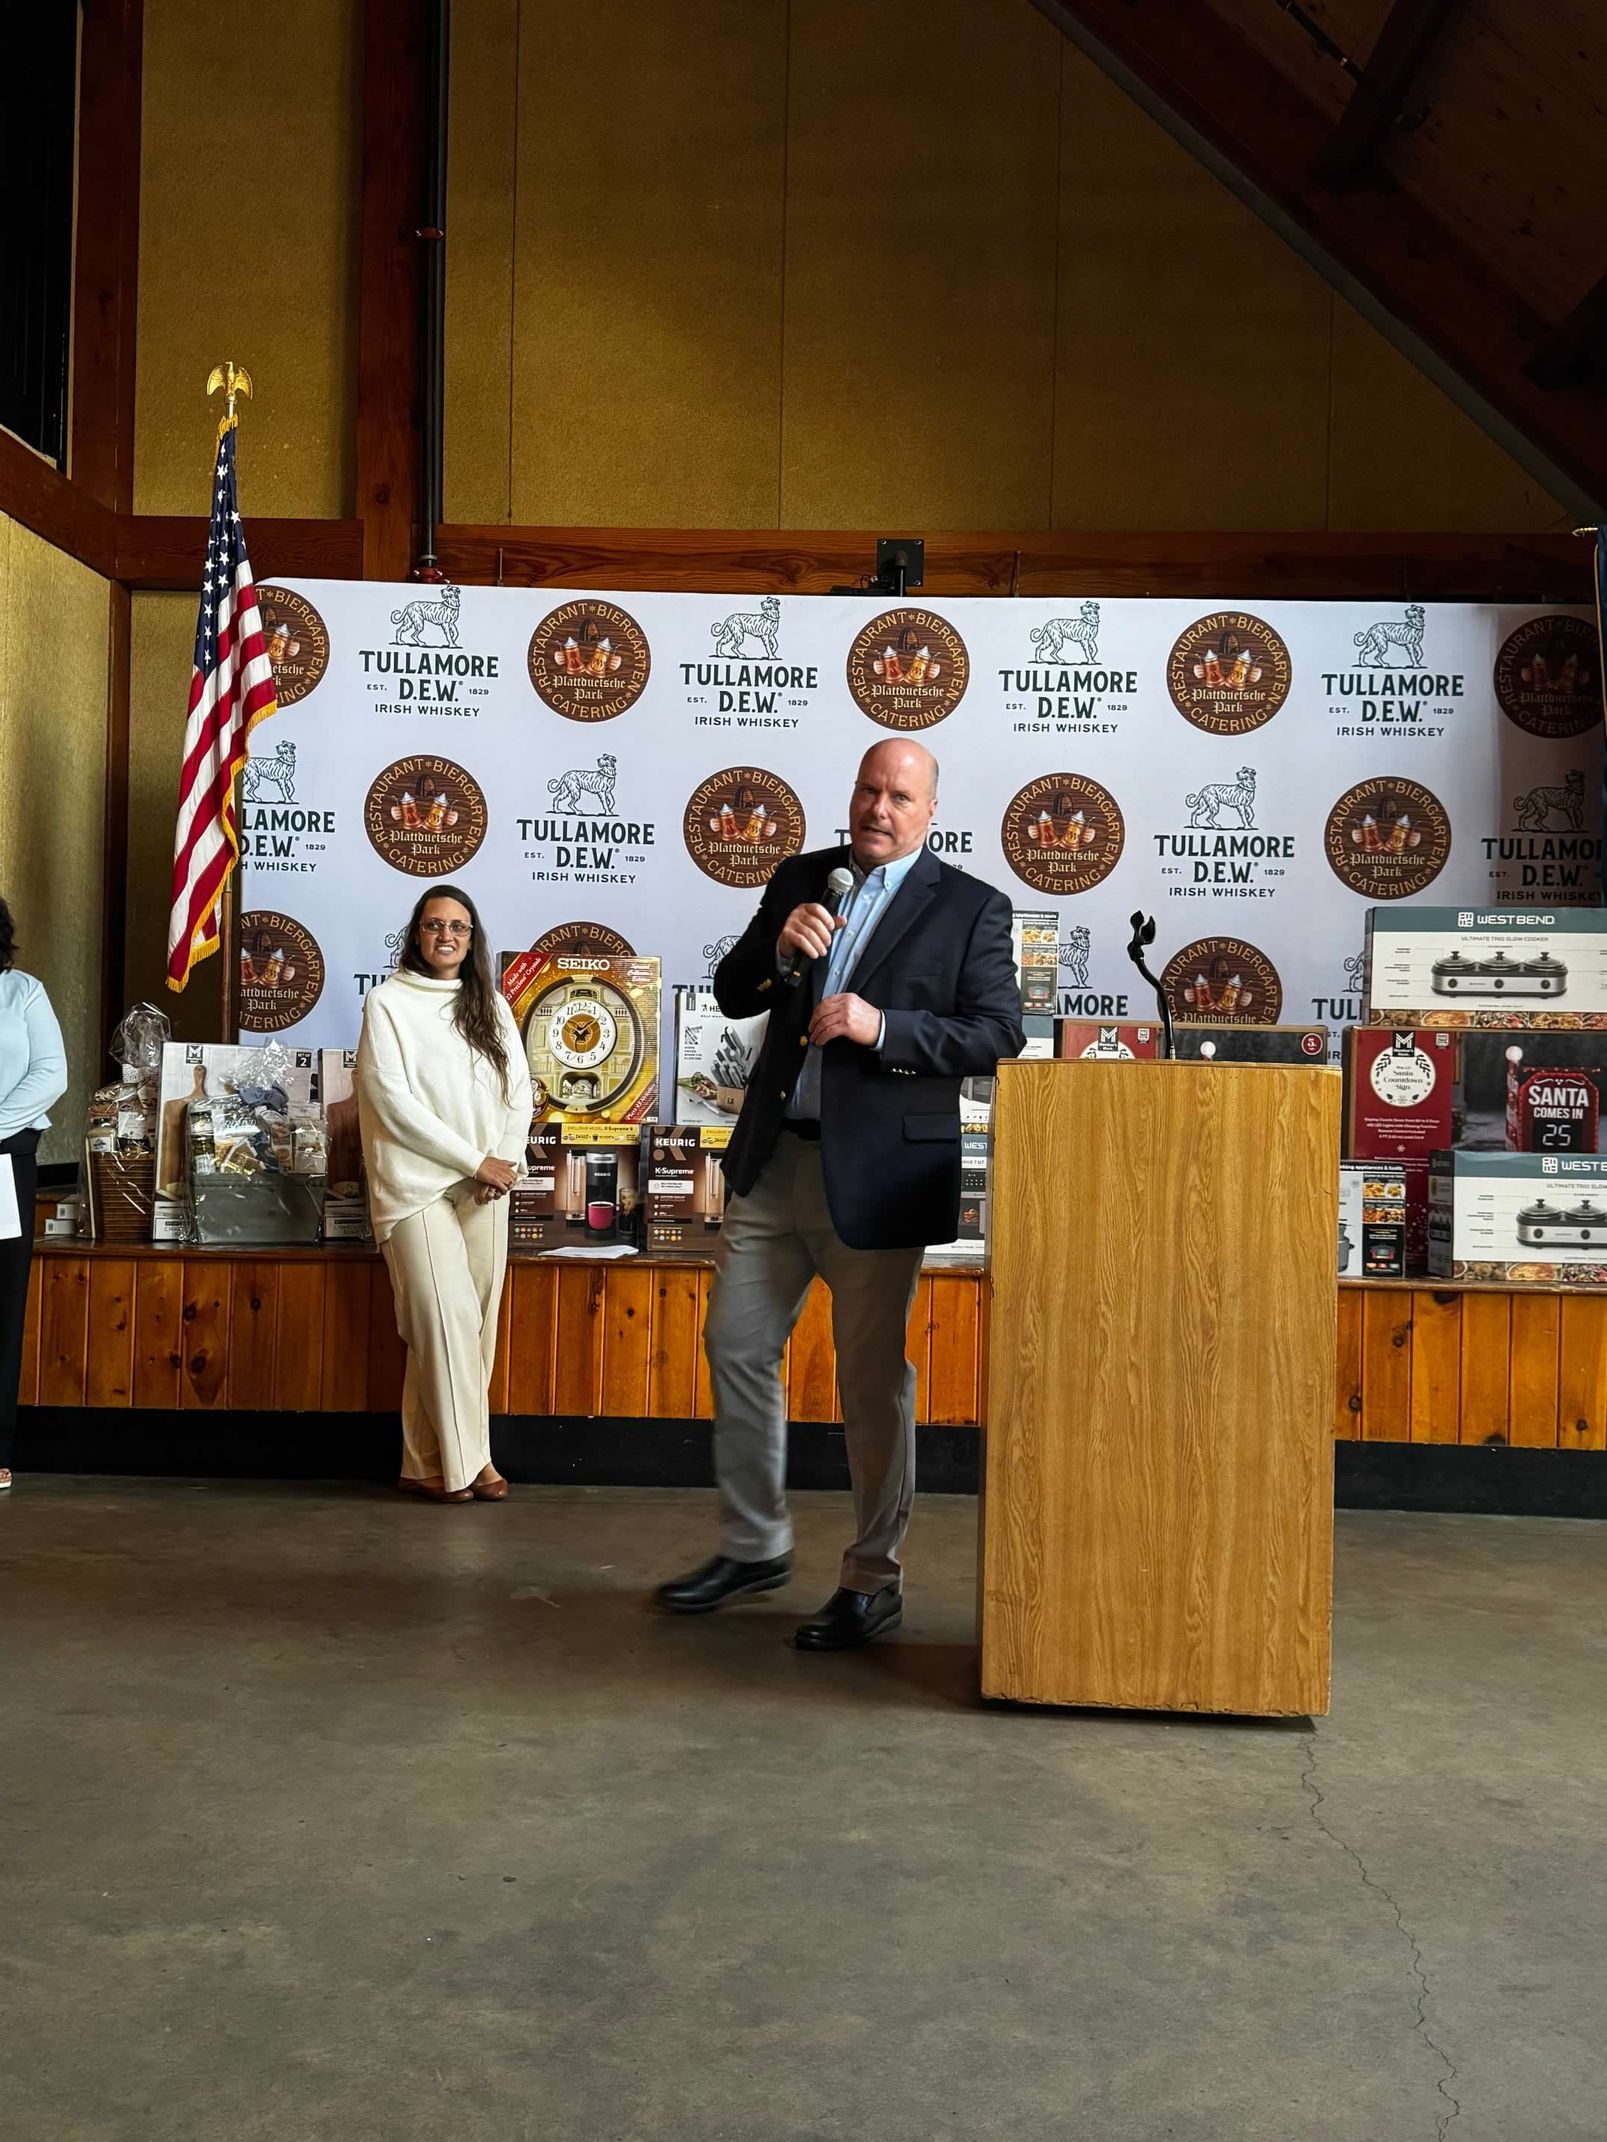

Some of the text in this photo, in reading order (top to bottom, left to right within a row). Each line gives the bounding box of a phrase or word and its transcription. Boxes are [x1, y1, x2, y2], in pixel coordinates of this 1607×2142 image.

[274, 591, 325, 679] BIERGARTEN
[533, 603, 646, 692] RESTAURANT BIERGARTEN
[852, 612, 965, 701] RESTAURANT BIERGARTEN
[359, 650, 499, 678] TULLAMORE
[1172, 615, 1288, 705] RESTAURANT BIERGARTEN
[679, 664, 818, 688] TULLAMORE
[998, 670, 1137, 693] TULLAMORE
[1321, 674, 1464, 696] TULLAMORE
[469, 688, 489, 696] 1829
[574, 688, 603, 700] Park
[893, 696, 922, 709] Park
[375, 704, 480, 717] IRISH WHISKEY
[552, 694, 627, 718] CATERING
[870, 702, 946, 728] CATERING
[1213, 701, 1243, 714] Park
[695, 717, 799, 728] IRISH WHISKEY
[1014, 723, 1118, 733] IRISH WHISKEY
[1190, 706, 1267, 732] CATERING
[1337, 727, 1444, 737] IRISH WHISKEY
[369, 758, 483, 848] RESTAURANT BIERGARTEN
[688, 770, 744, 855] RESTAURANT
[242, 809, 335, 833] LAMORE
[1006, 776, 1120, 865] RESTAURANT BIERGARTEN
[1330, 780, 1447, 869] RESTAURANT BIERGARTEN
[516, 819, 655, 845] TULLAMORE
[411, 843, 440, 855] Park
[1154, 835, 1294, 858] TULLAMORE
[254, 862, 317, 872] WHISKEY
[388, 849, 465, 873] CATERING
[730, 854, 758, 866] Park
[1048, 861, 1077, 874] Park
[532, 872, 636, 884] IRISH WHISKEY
[1025, 866, 1101, 892] CATERING
[1372, 865, 1402, 878] Park
[1169, 888, 1275, 898] IRISH WHISKEY
[1349, 870, 1427, 896] CATERING
[1497, 891, 1535, 900] IRISH
[270, 916, 320, 1003] BIERGARTEN
[558, 958, 610, 970] SEIKO
[247, 998, 277, 1011] Park
[300, 1058, 307, 1066] 2
[1528, 1085, 1589, 1107] SANTA
[1534, 1107, 1584, 1119] COMES IN
[655, 1138, 696, 1147] KEURIG
[1542, 1124, 1572, 1146] 25
